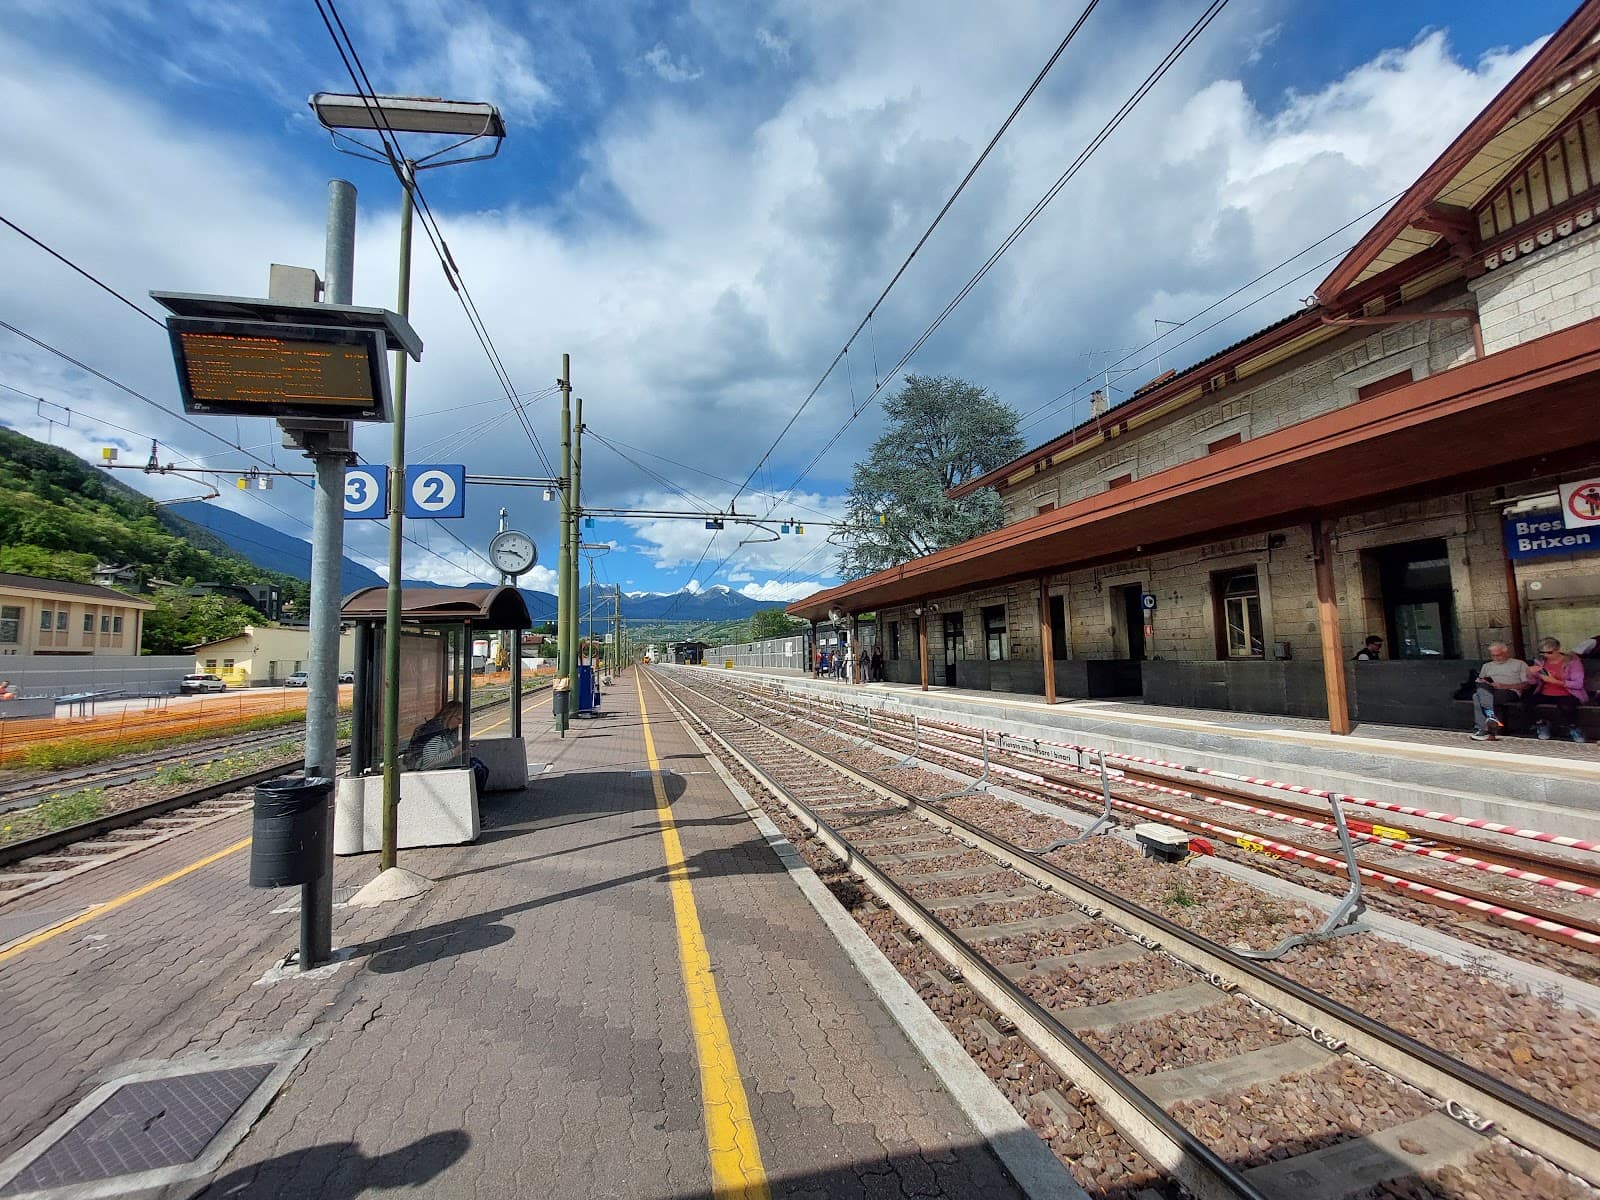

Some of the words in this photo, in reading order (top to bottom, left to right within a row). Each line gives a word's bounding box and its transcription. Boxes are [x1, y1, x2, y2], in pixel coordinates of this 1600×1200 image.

[345, 478, 367, 504] 3
[423, 478, 444, 503] 2
[1516, 520, 1563, 535] Bres
[1518, 533, 1590, 552] Brixen
